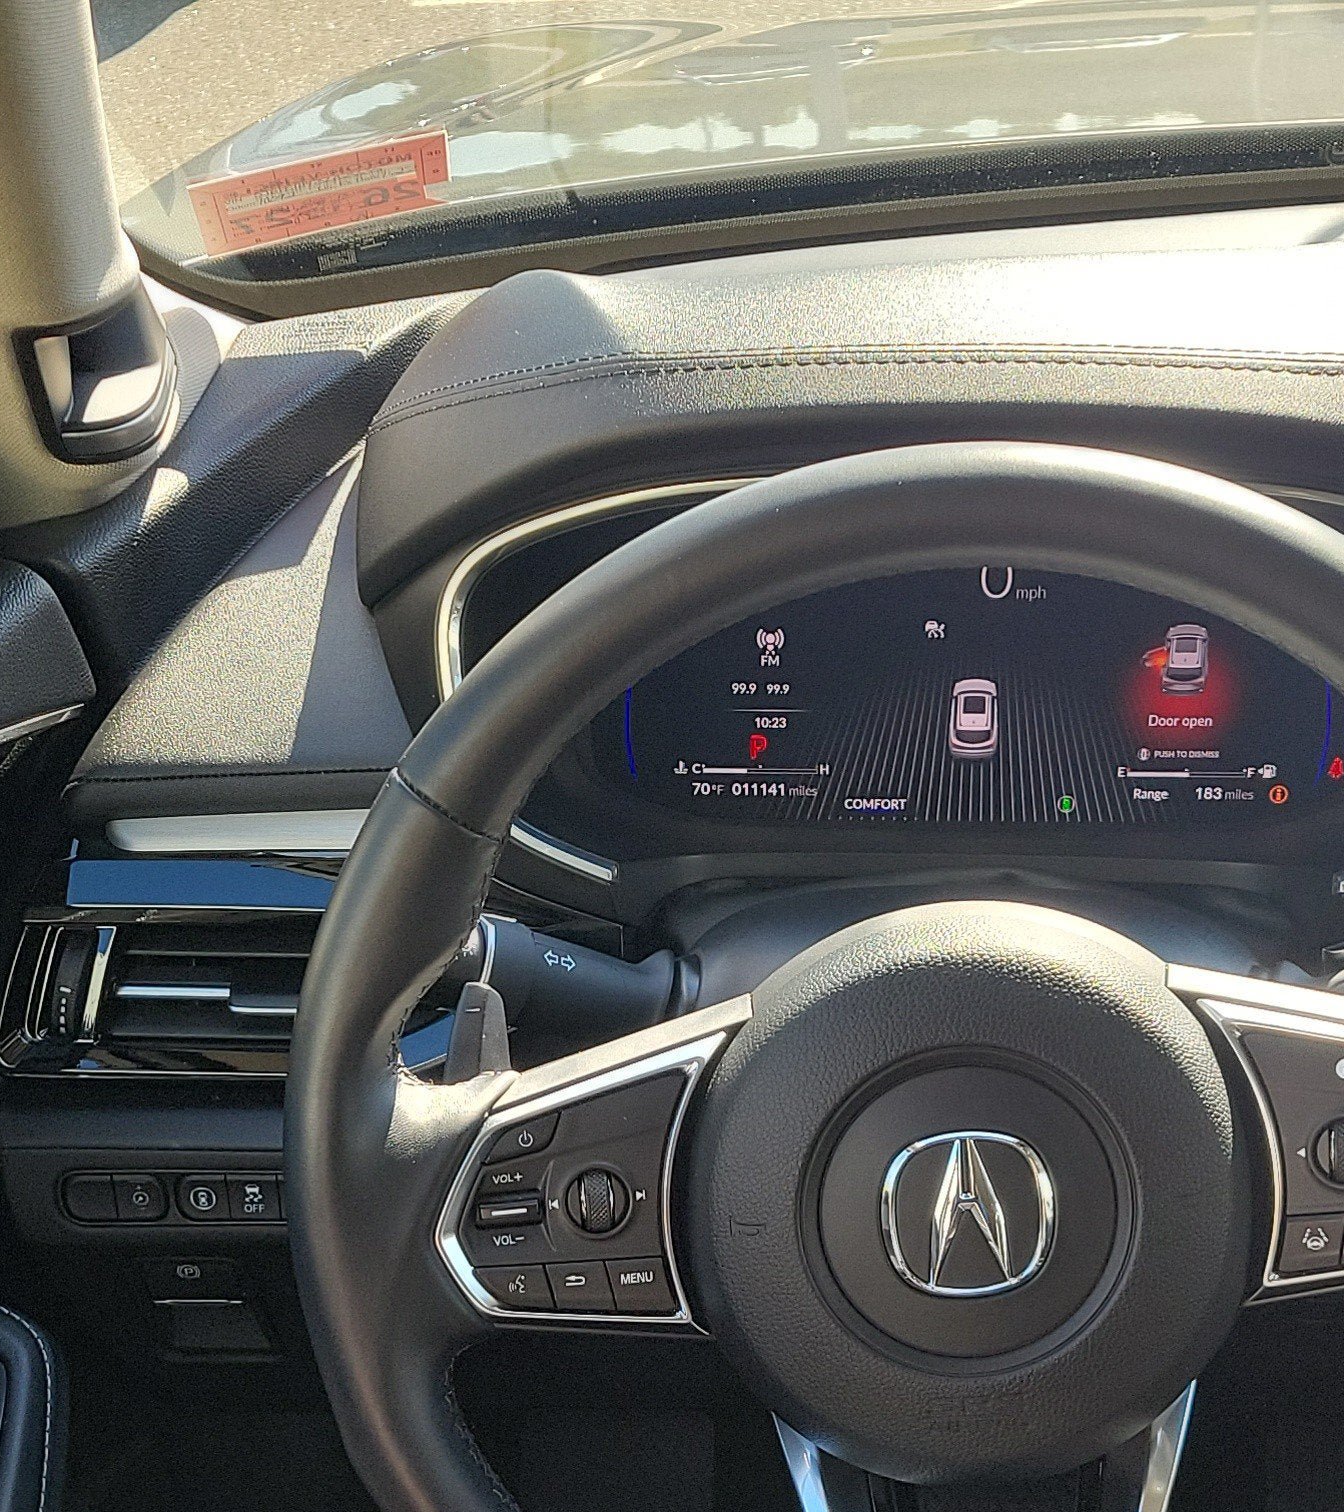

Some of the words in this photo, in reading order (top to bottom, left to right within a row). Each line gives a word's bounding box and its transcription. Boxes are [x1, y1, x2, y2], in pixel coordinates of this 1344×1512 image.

[1015, 585, 1047, 601] mph
[760, 655, 780, 667] FM
[731, 682, 757, 695] 99.9
[766, 683, 790, 696] 99.9
[754, 716, 788, 729] 10:23
[1147, 715, 1179, 728] Door
[1181, 717, 1213, 730] open
[749, 733, 768, 760] P
[1176, 749, 1188, 759] TO
[819, 764, 830, 776] H
[1117, 767, 1127, 779] E
[1247, 767, 1256, 779] F
[731, 783, 786, 798] 011141
[788, 784, 818, 797] miles
[1133, 788, 1170, 802] Range
[1194, 787, 1223, 801] 183
[1224, 788, 1255, 801] miles
[844, 798, 907, 811] COMFORT
[243, 1203, 266, 1214] OFF
[620, 1271, 654, 1286] MENU
